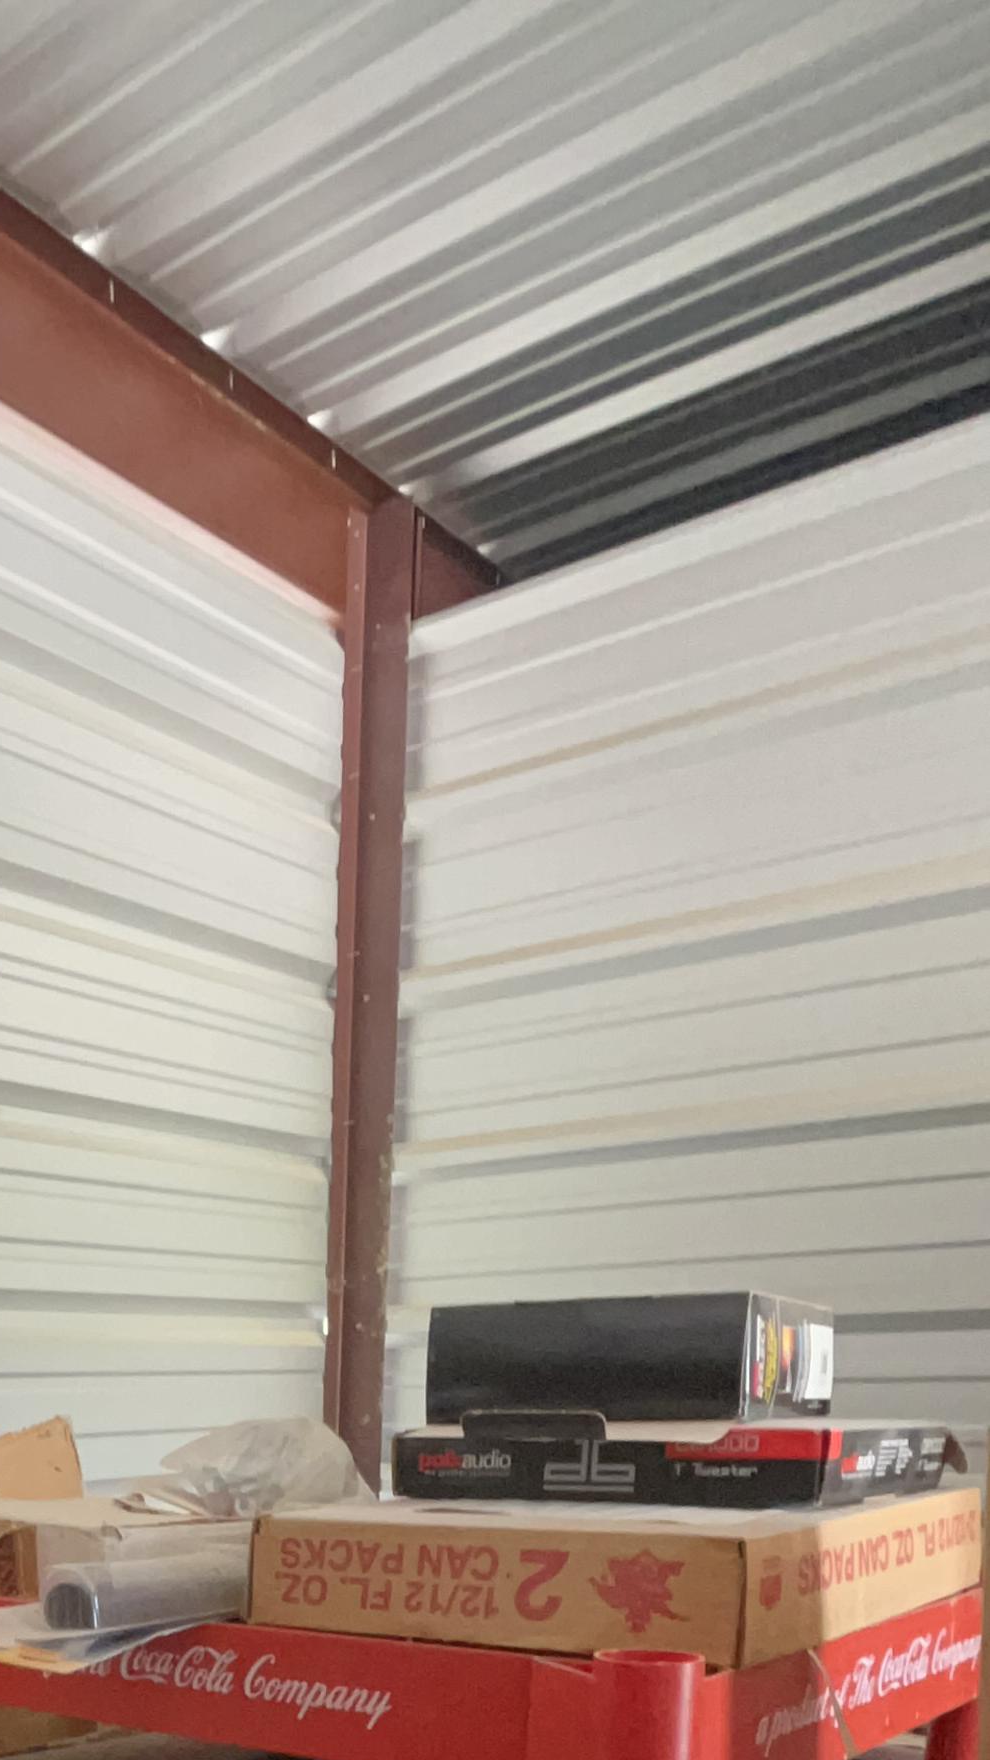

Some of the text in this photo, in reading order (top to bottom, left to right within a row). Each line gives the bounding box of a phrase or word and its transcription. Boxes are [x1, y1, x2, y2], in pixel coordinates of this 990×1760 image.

[280, 1537, 500, 1582] CAN PACKS
[797, 1542, 855, 1597] PACKS
[860, 1534, 890, 1578] CAN
[404, 1580, 500, 1619] 12/12
[514, 1550, 570, 1622] 2
[243, 1654, 392, 1730] Company
